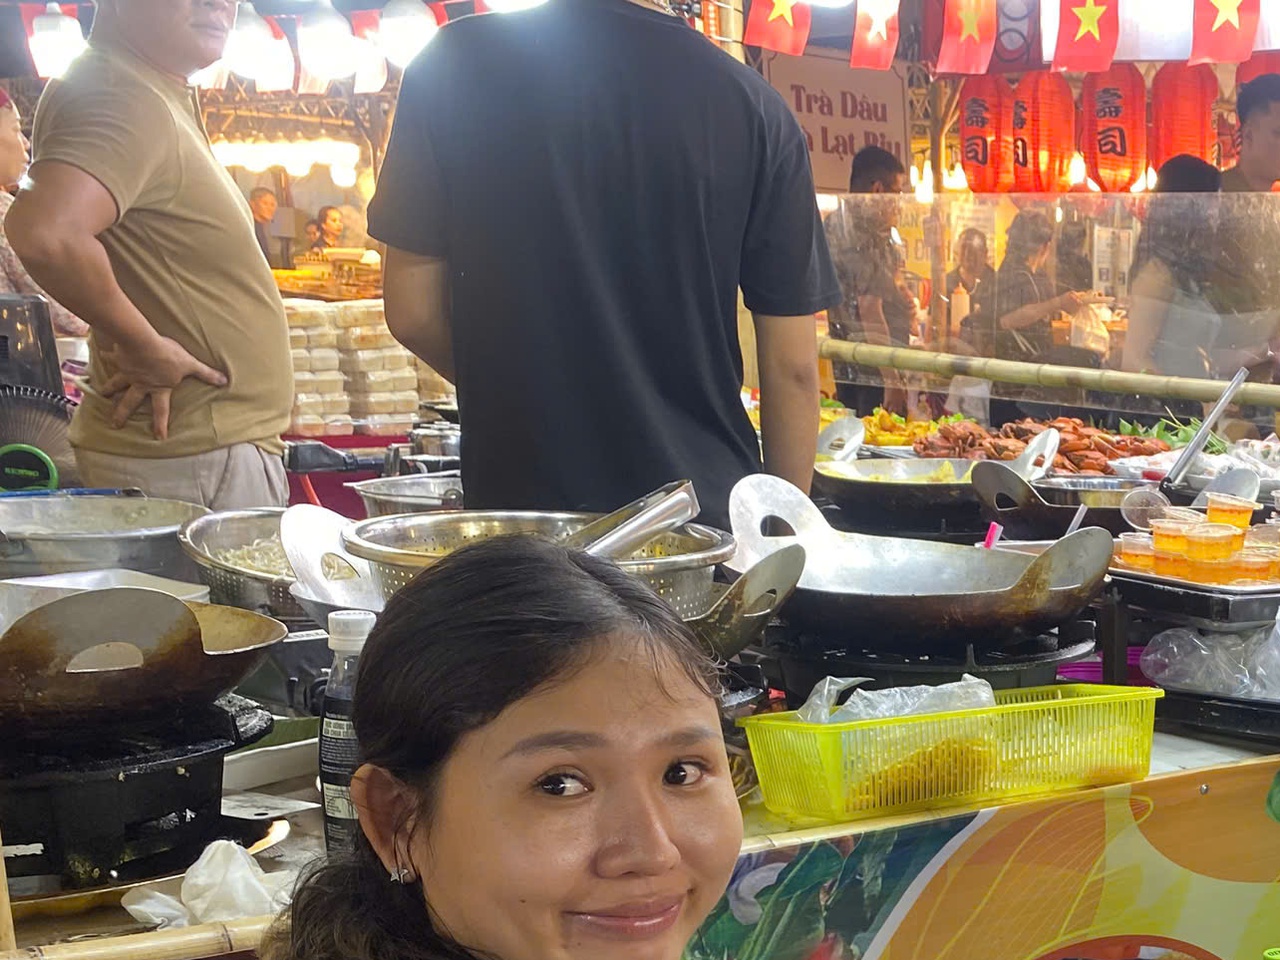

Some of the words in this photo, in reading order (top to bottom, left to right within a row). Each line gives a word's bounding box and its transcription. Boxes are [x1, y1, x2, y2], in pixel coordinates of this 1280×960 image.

[790, 83, 834, 117] Trà
[840, 90, 888, 123] Dâu
[820, 125, 857, 162] Lạt
